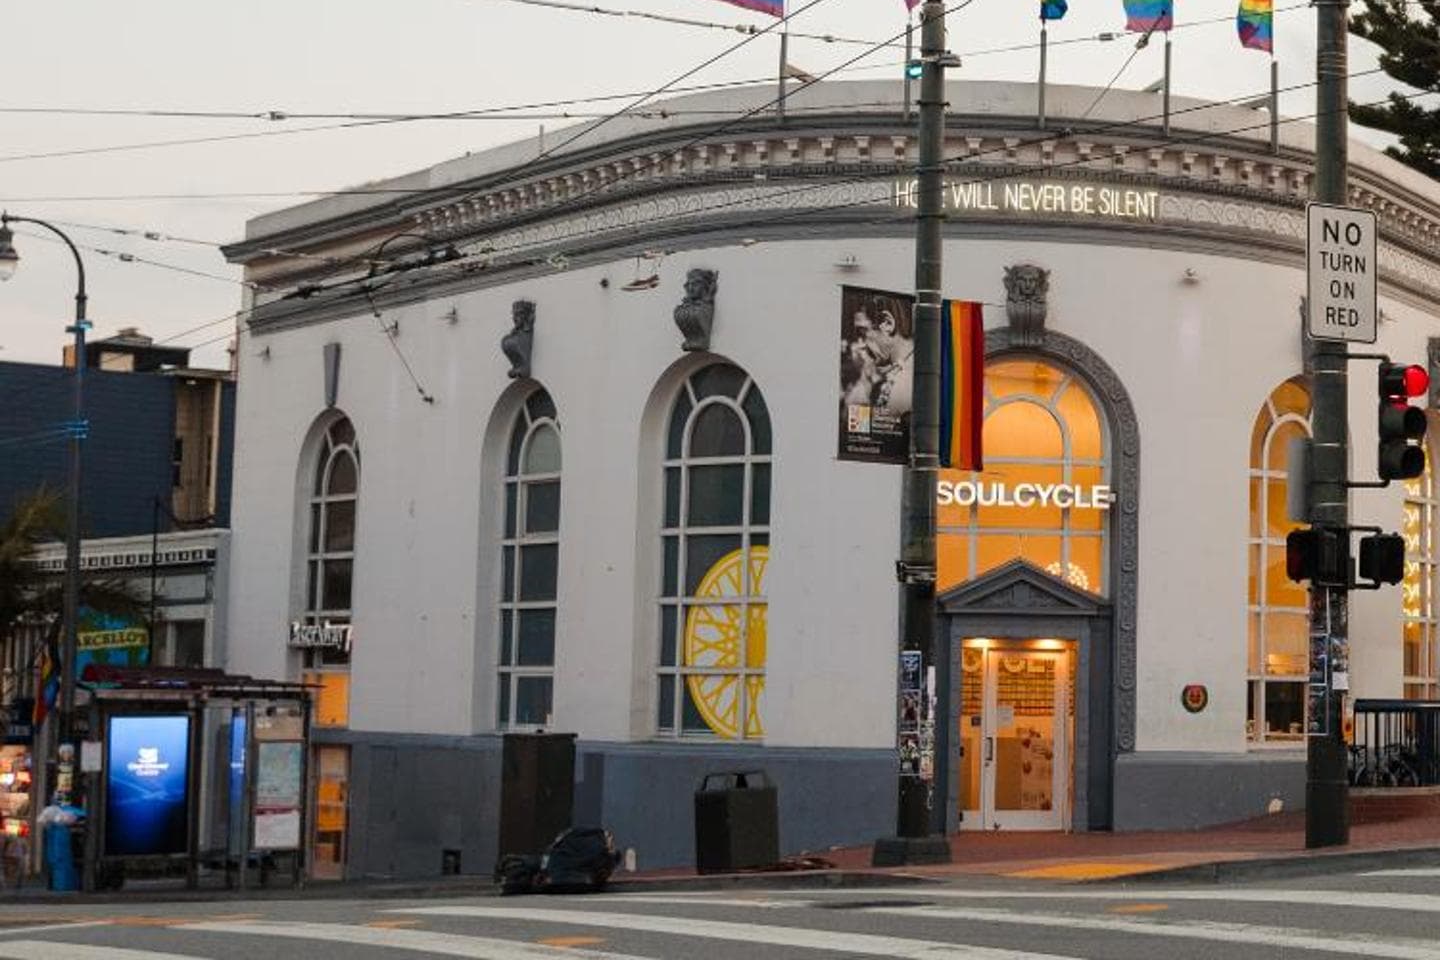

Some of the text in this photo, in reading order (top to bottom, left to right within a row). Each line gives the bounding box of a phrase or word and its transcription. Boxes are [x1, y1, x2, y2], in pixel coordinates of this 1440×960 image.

[951, 182, 999, 210] WILL
[1004, 182, 1067, 212] NEVER
[1070, 186, 1096, 214] BE
[1097, 188, 1158, 218] SILENT
[1322, 218, 1362, 246] NO
[1319, 251, 1367, 274] TURN
[1329, 279, 1356, 300] ON
[1325, 306, 1359, 327] RED
[936, 481, 1111, 510] SOULCYCLE
